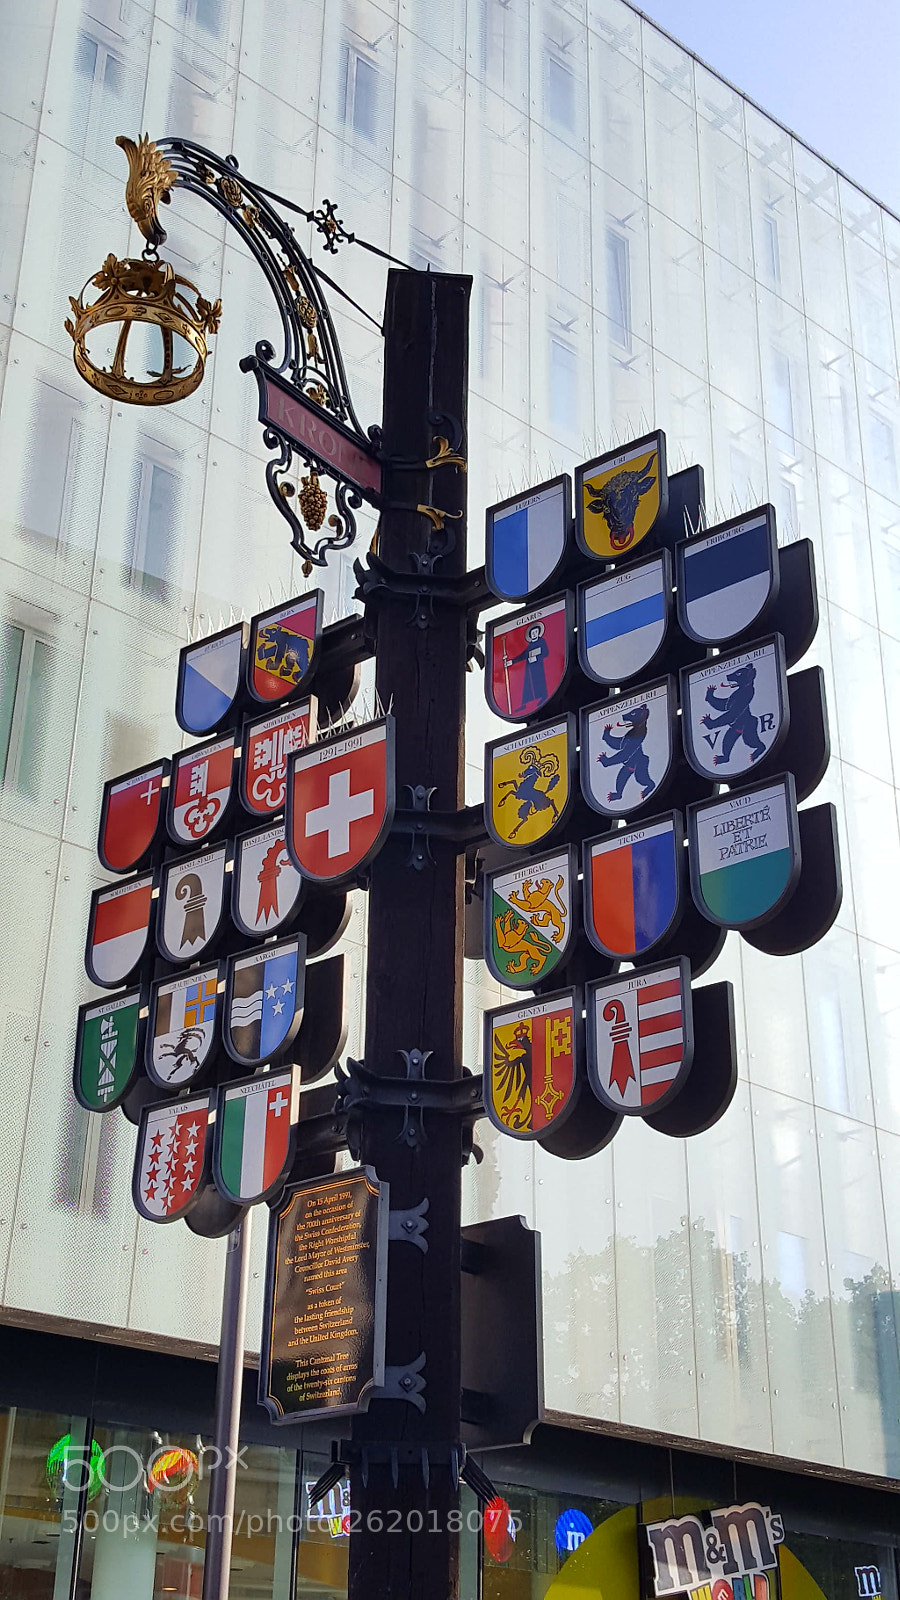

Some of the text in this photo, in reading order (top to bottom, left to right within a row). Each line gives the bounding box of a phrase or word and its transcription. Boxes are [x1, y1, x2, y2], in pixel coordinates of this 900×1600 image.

[612, 455, 627, 467] URI
[514, 494, 541, 511] LUZERN
[705, 525, 745, 547] FRIBOURG
[615, 572, 631, 585] ZUG
[515, 610, 543, 626] GLARUS
[698, 655, 743, 679] APPENZELL
[597, 693, 638, 718] APPENZELL
[757, 713, 776, 734] R
[503, 728, 557, 752] SCHAFFHAUSEN
[702, 731, 720, 750] V
[318, 736, 364, 762] 1291-1991
[729, 796, 751, 810] VAUD
[712, 804, 772, 838] LIBERTÉ
[617, 831, 646, 846] TICINO
[732, 826, 753, 843] ET
[718, 832, 769, 861] PATRIE
[512, 863, 548, 879] THURGAU
[253, 950, 277, 962] AARGAU
[627, 978, 648, 990] JURA
[324, 1196, 338, 1205] April
[323, 1204, 346, 1214] occasion
[306, 1219, 321, 1228] 700th
[322, 1212, 354, 1226] anniversary
[304, 1230, 320, 1240] Swiss
[308, 1240, 324, 1250] Right
[325, 1232, 356, 1245] Worshipful
[294, 1253, 307, 1262] Lord
[308, 1250, 327, 1260] Mayor
[324, 1256, 340, 1266] David
[342, 1255, 359, 1264] Avery
[304, 1270, 323, 1282] named
[324, 1269, 334, 1278] this
[318, 1300, 334, 1308] token
[304, 1312, 323, 1322] lasting
[324, 1306, 354, 1318] friendship
[294, 1317, 352, 1335] between Switzerland
[310, 1332, 329, 1343] United
[296, 1352, 349, 1368] This Cantonal Tree
[286, 1371, 309, 1382] displays
[320, 1366, 335, 1374] coats
[343, 1363, 358, 1371] arms
[303, 1378, 333, 1389] twenty-six
[333, 1375, 356, 1384] cantons
